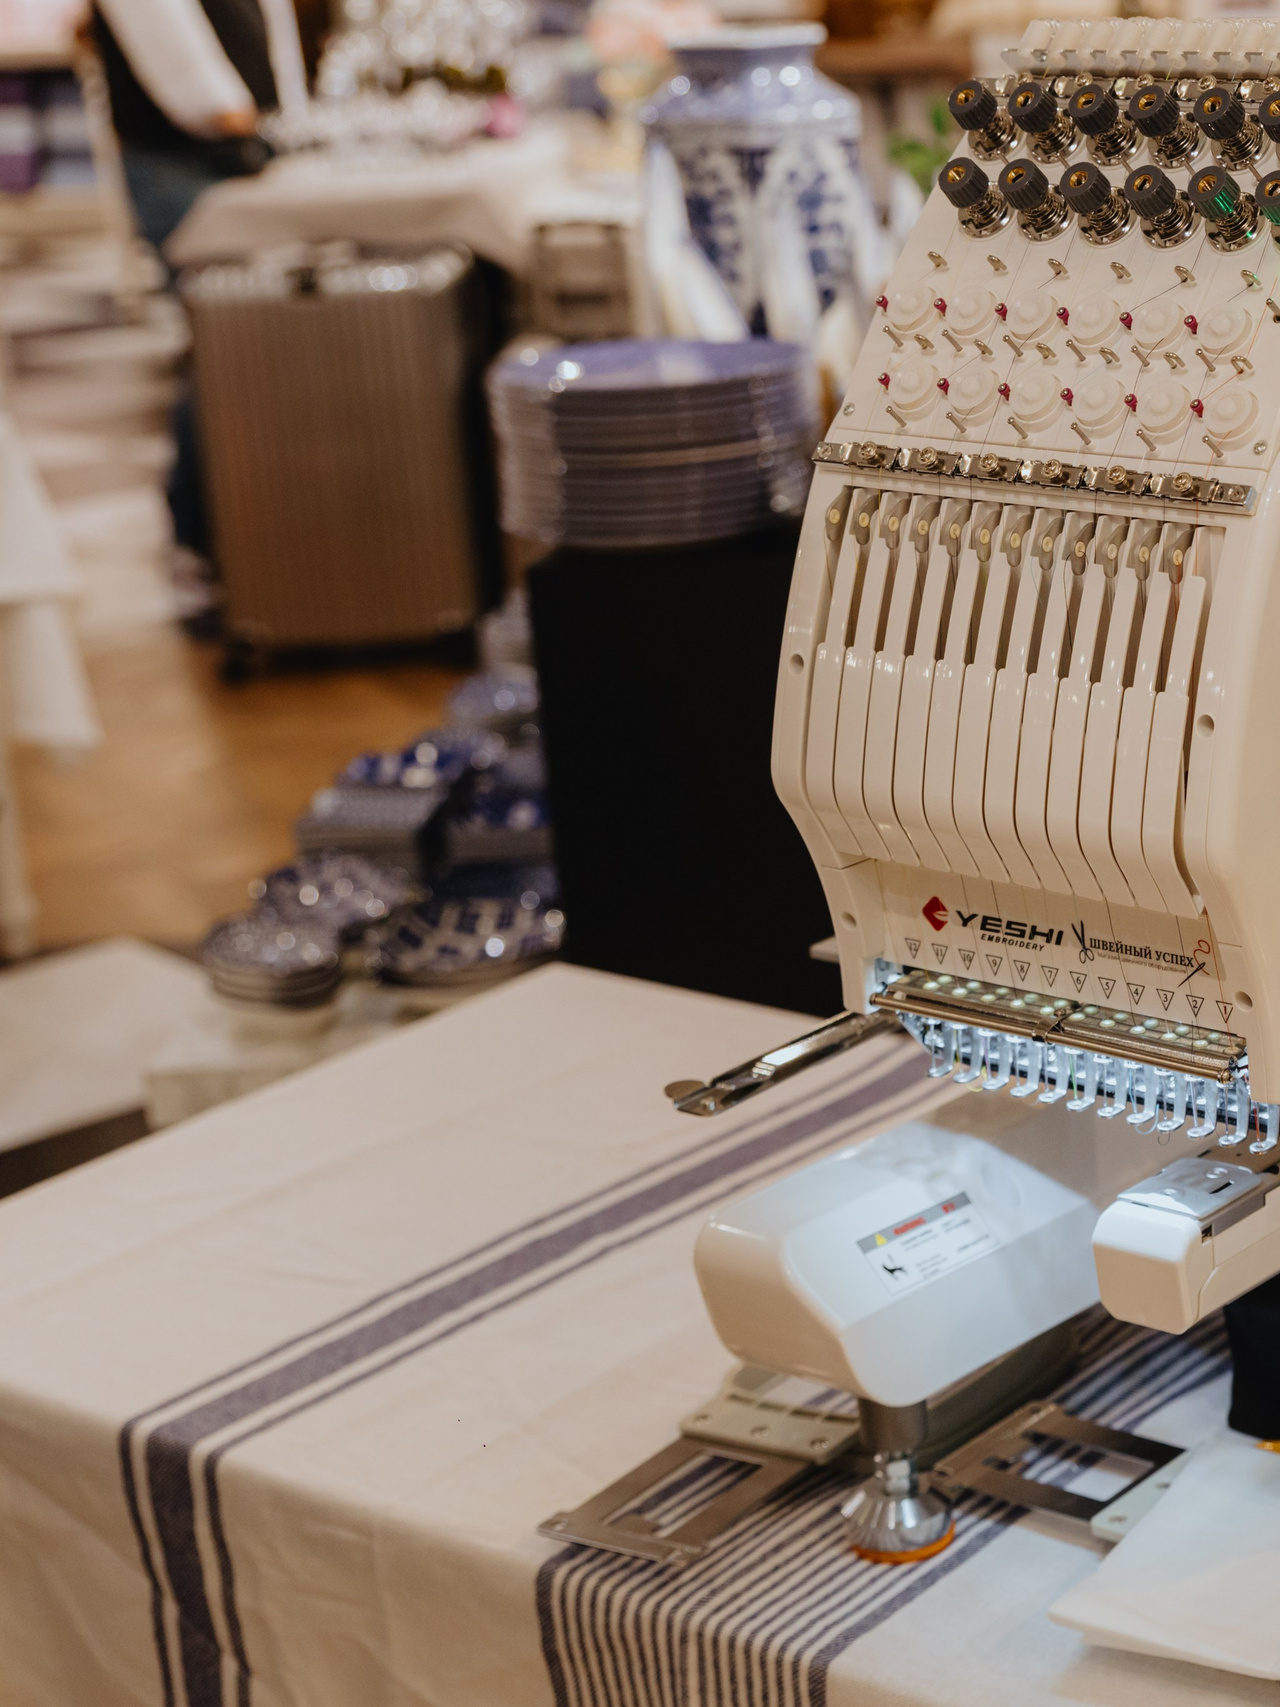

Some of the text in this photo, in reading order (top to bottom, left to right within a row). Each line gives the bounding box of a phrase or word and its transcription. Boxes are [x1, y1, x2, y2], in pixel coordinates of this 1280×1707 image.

[955, 910, 1064, 946] YESHI
[980, 933, 1045, 952] EMBROIDERY
[1089, 938, 1195, 968] ШВЕЙНЫЙ УСПЕХ
[992, 959, 997, 968] 9
[1019, 964, 1025, 973] 8
[1047, 969, 1053, 978] 7
[1076, 976, 1082, 986] 6
[1104, 981, 1110, 991] 5
[1133, 988, 1139, 997] 4
[1163, 993, 1168, 1003] 3
[1192, 999, 1198, 1009] 2
[1223, 1005, 1228, 1015] 1
